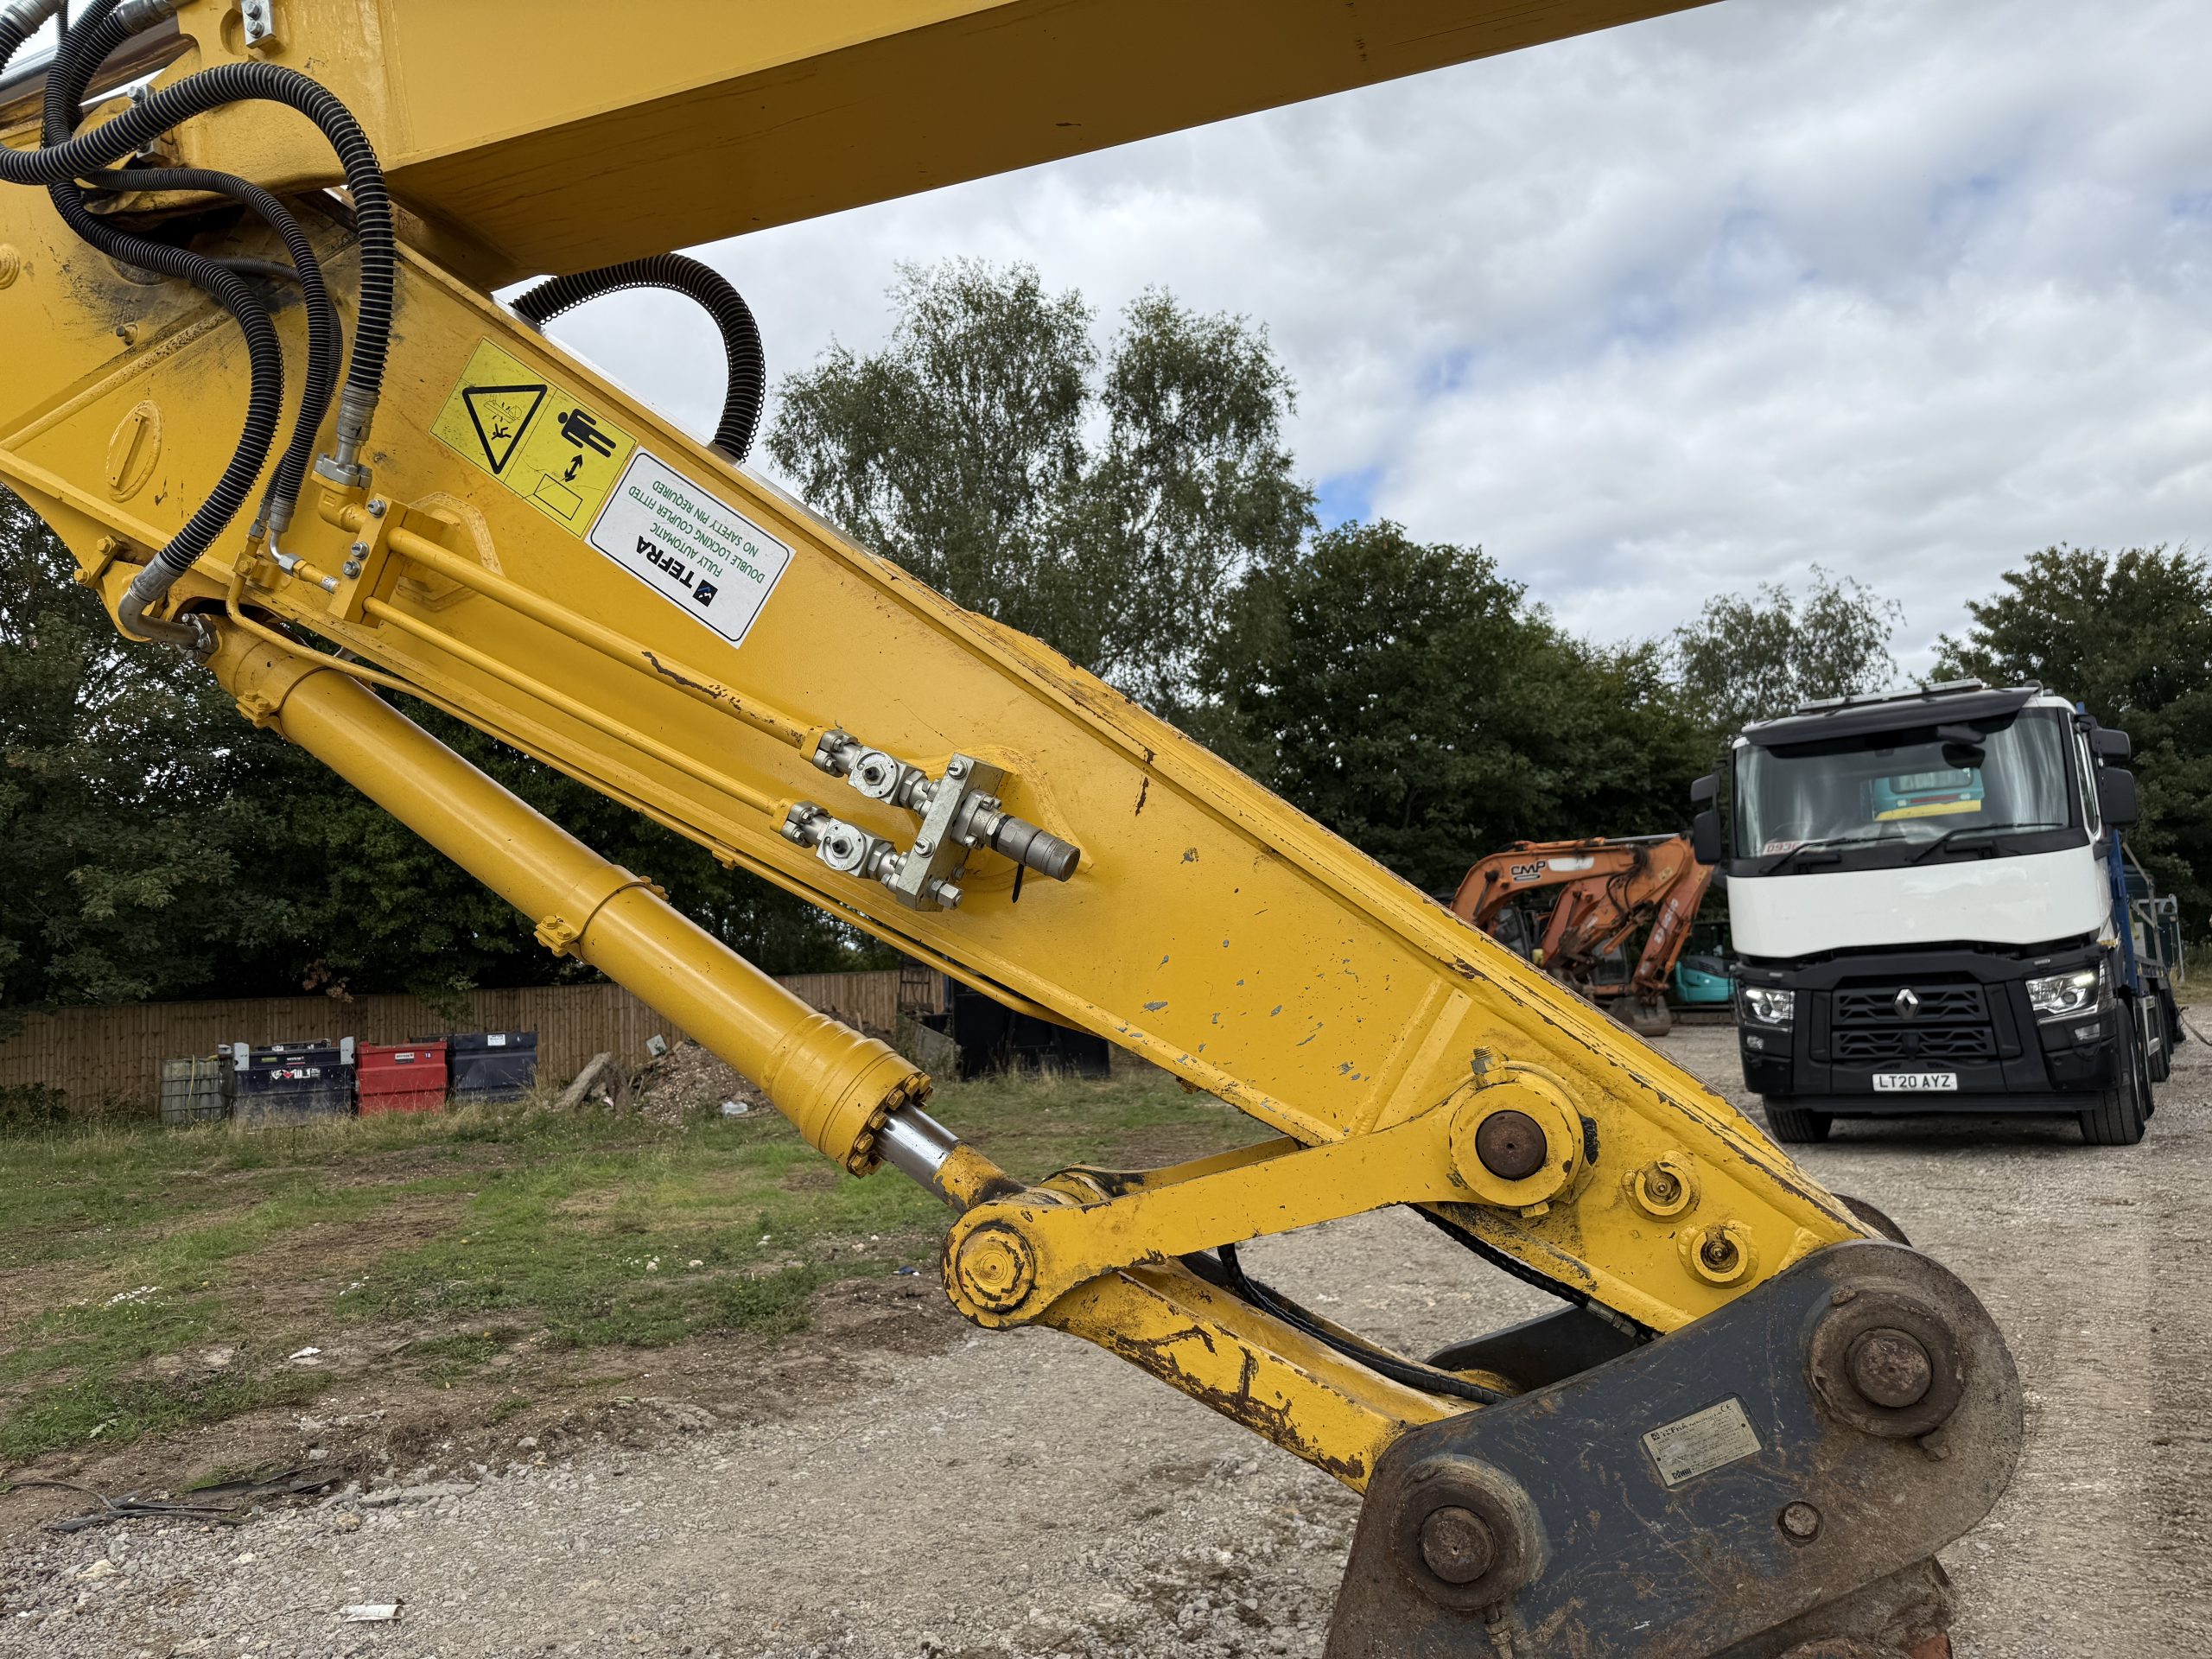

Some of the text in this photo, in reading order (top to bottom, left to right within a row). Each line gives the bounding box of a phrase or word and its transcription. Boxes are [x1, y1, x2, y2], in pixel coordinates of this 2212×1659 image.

[628, 485, 766, 585] DOUBLE LOCKING COUPLER FITTED
[652, 480, 760, 558] NO SAFETY PIN REQUIRED
[635, 534, 695, 589] TEFRA
[649, 522, 723, 577] FULLY AUTOMATIC
[1510, 860, 1547, 875] CMP
[1878, 1075, 1951, 1088] LT20 AYZ
